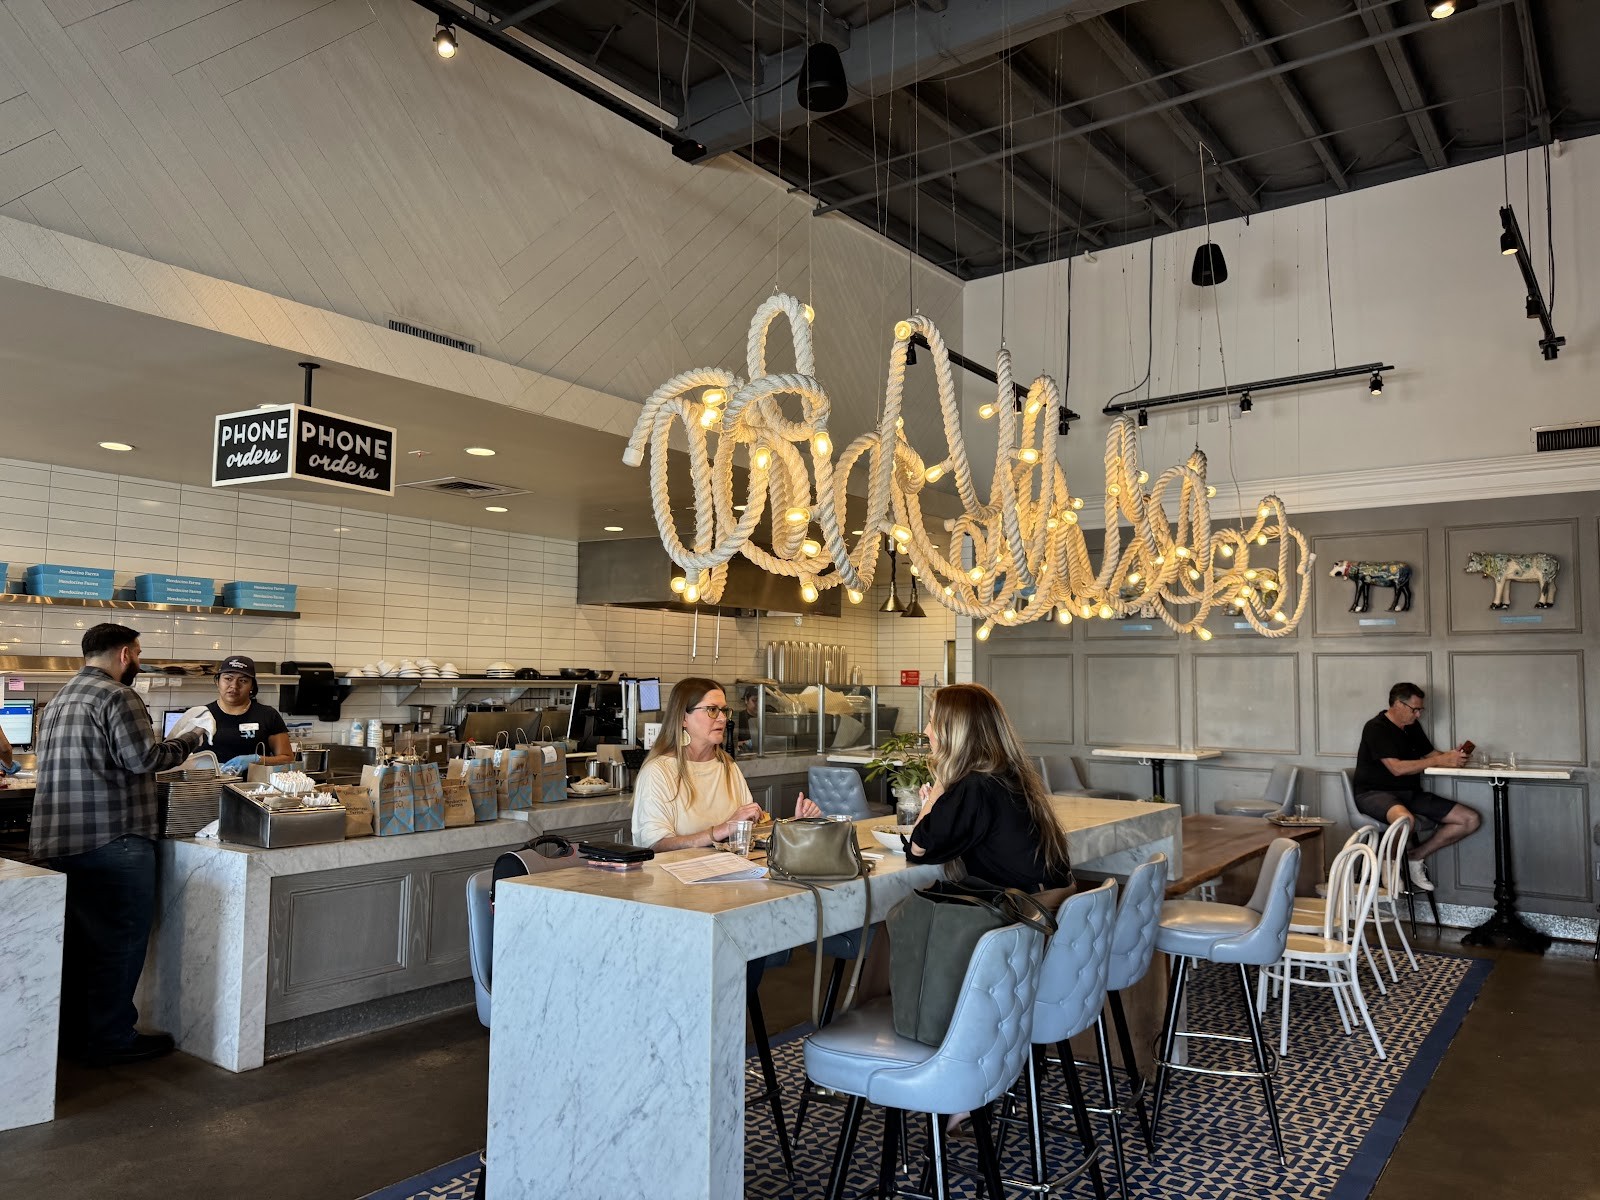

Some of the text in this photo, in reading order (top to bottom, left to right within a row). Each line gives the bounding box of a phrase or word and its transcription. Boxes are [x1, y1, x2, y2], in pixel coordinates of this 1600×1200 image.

[221, 417, 289, 447] PHONE
[301, 421, 388, 461] PHONE
[226, 444, 282, 468] orders
[308, 453, 379, 480] orders
